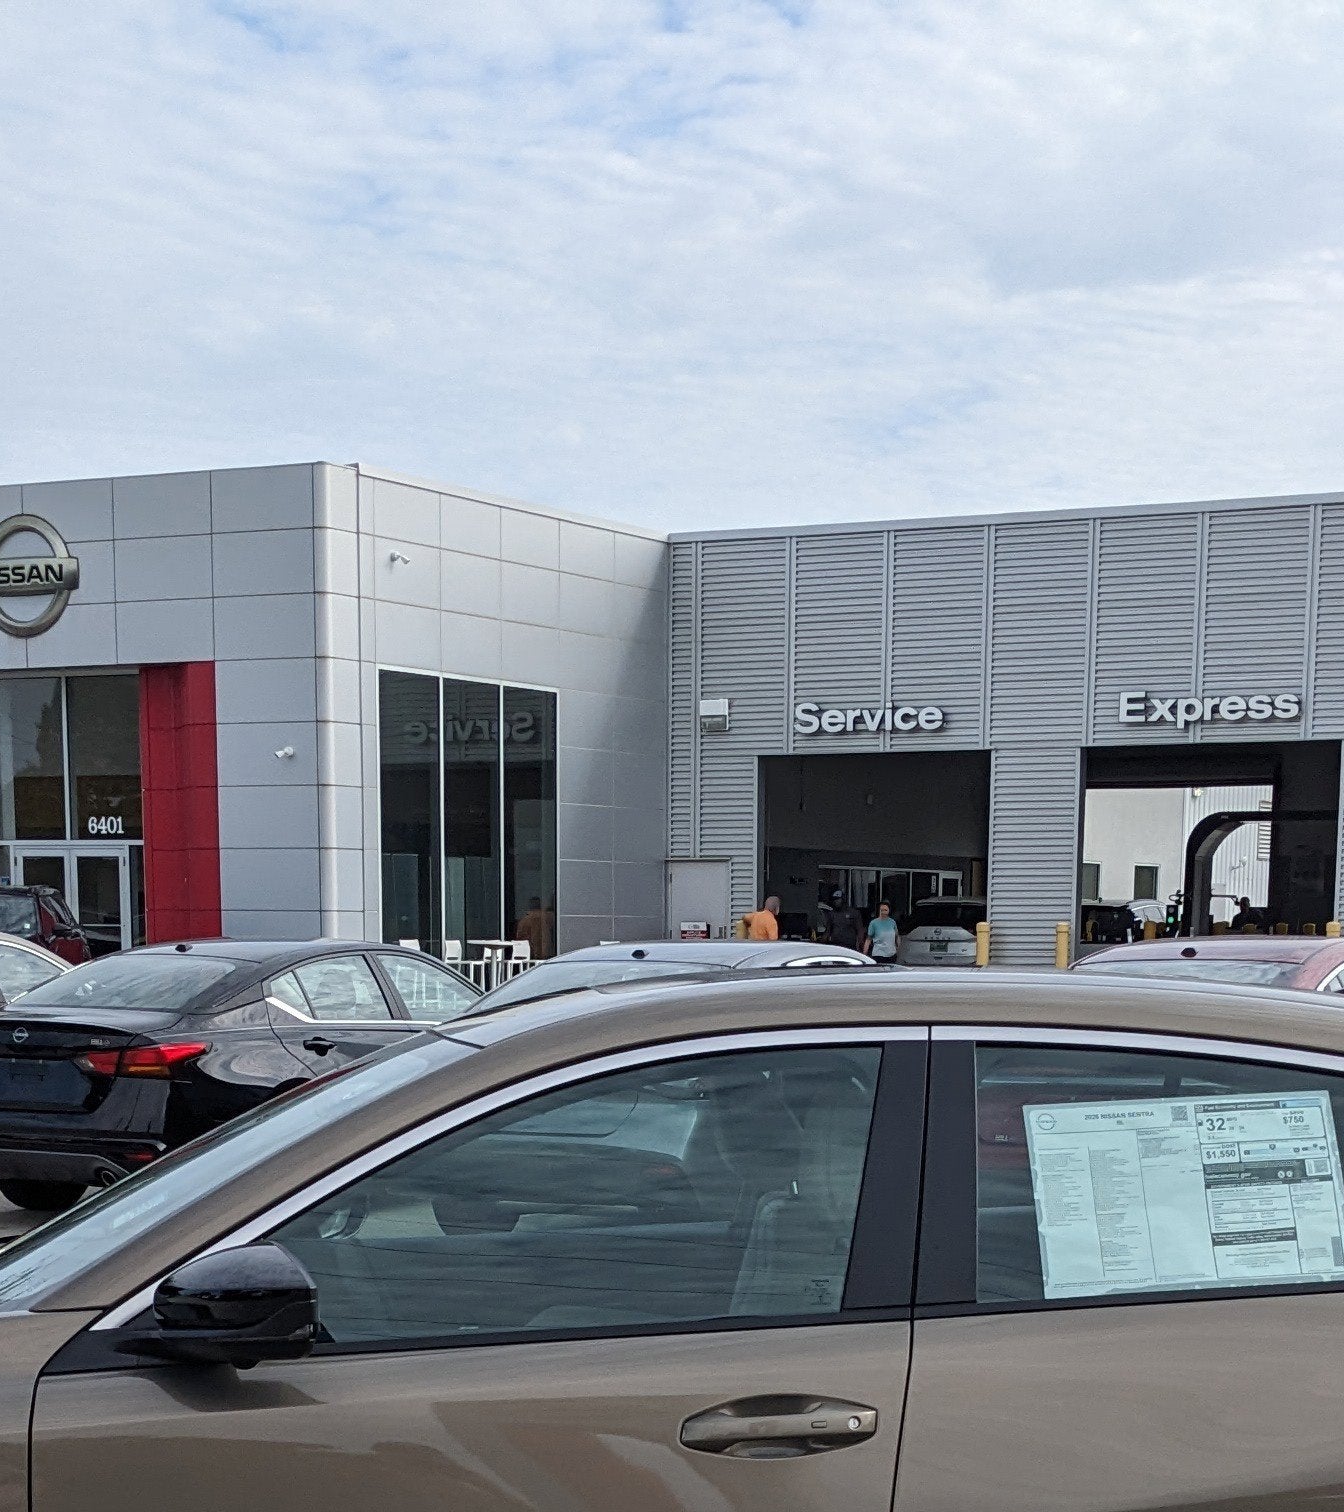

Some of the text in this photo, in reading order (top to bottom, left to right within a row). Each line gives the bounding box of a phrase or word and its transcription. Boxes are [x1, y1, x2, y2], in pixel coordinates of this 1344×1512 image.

[793, 701, 944, 735] Service
[1118, 690, 1301, 730] Express
[88, 816, 125, 834] 6401
[1206, 1117, 1226, 1131] 32
[1206, 1149, 1236, 1160] $1,550
